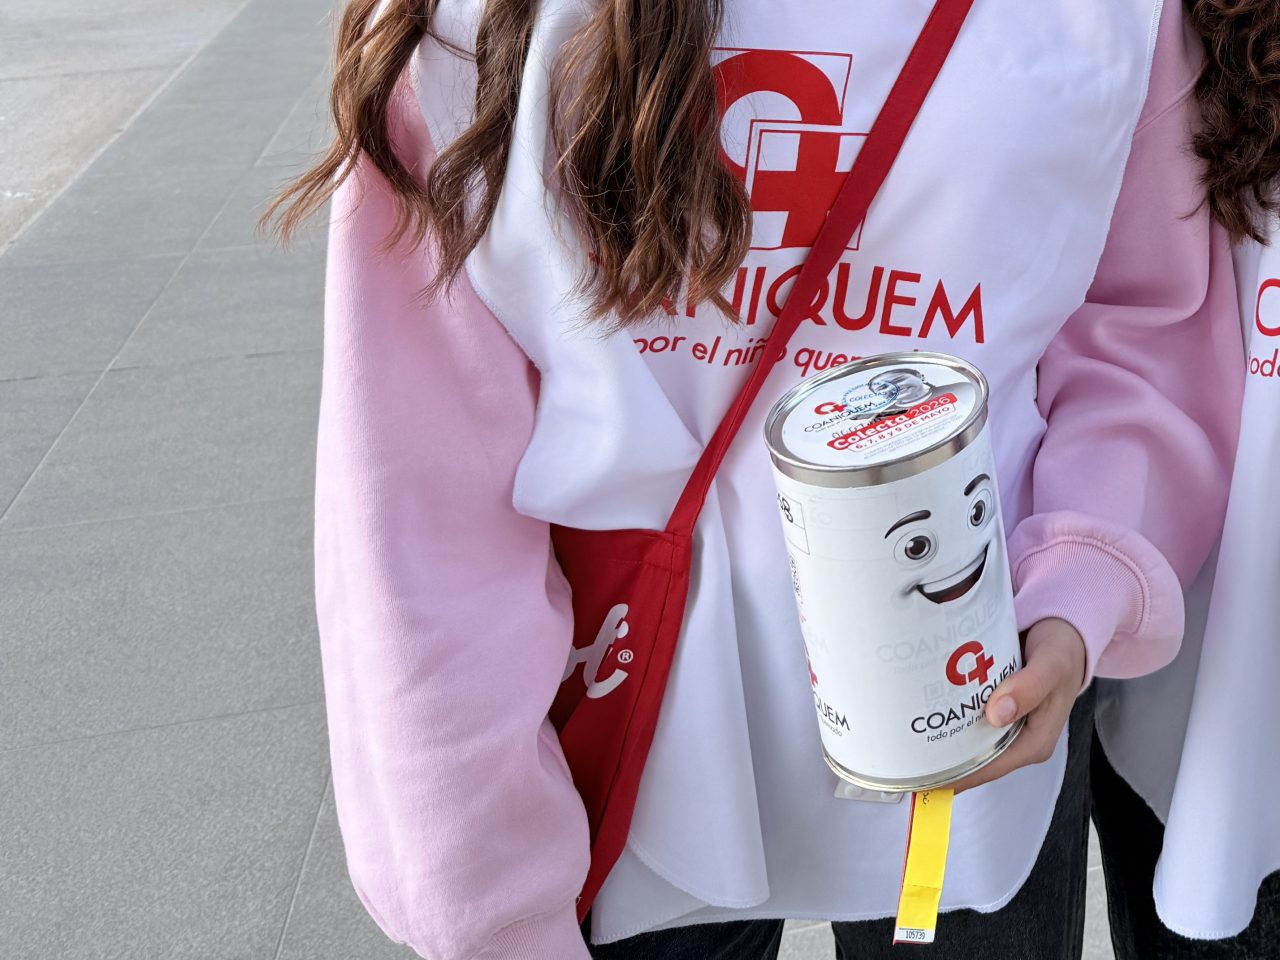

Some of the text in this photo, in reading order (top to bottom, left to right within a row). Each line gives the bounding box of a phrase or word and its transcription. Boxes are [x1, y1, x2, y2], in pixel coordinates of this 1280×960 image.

[692, 335, 722, 365] el
[804, 401, 877, 433] COANIQUEM
[833, 414, 909, 449] Colecta
[910, 396, 951, 417] 2026
[927, 730, 948, 743] todo
[950, 722, 965, 738] por
[966, 716, 974, 728] el
